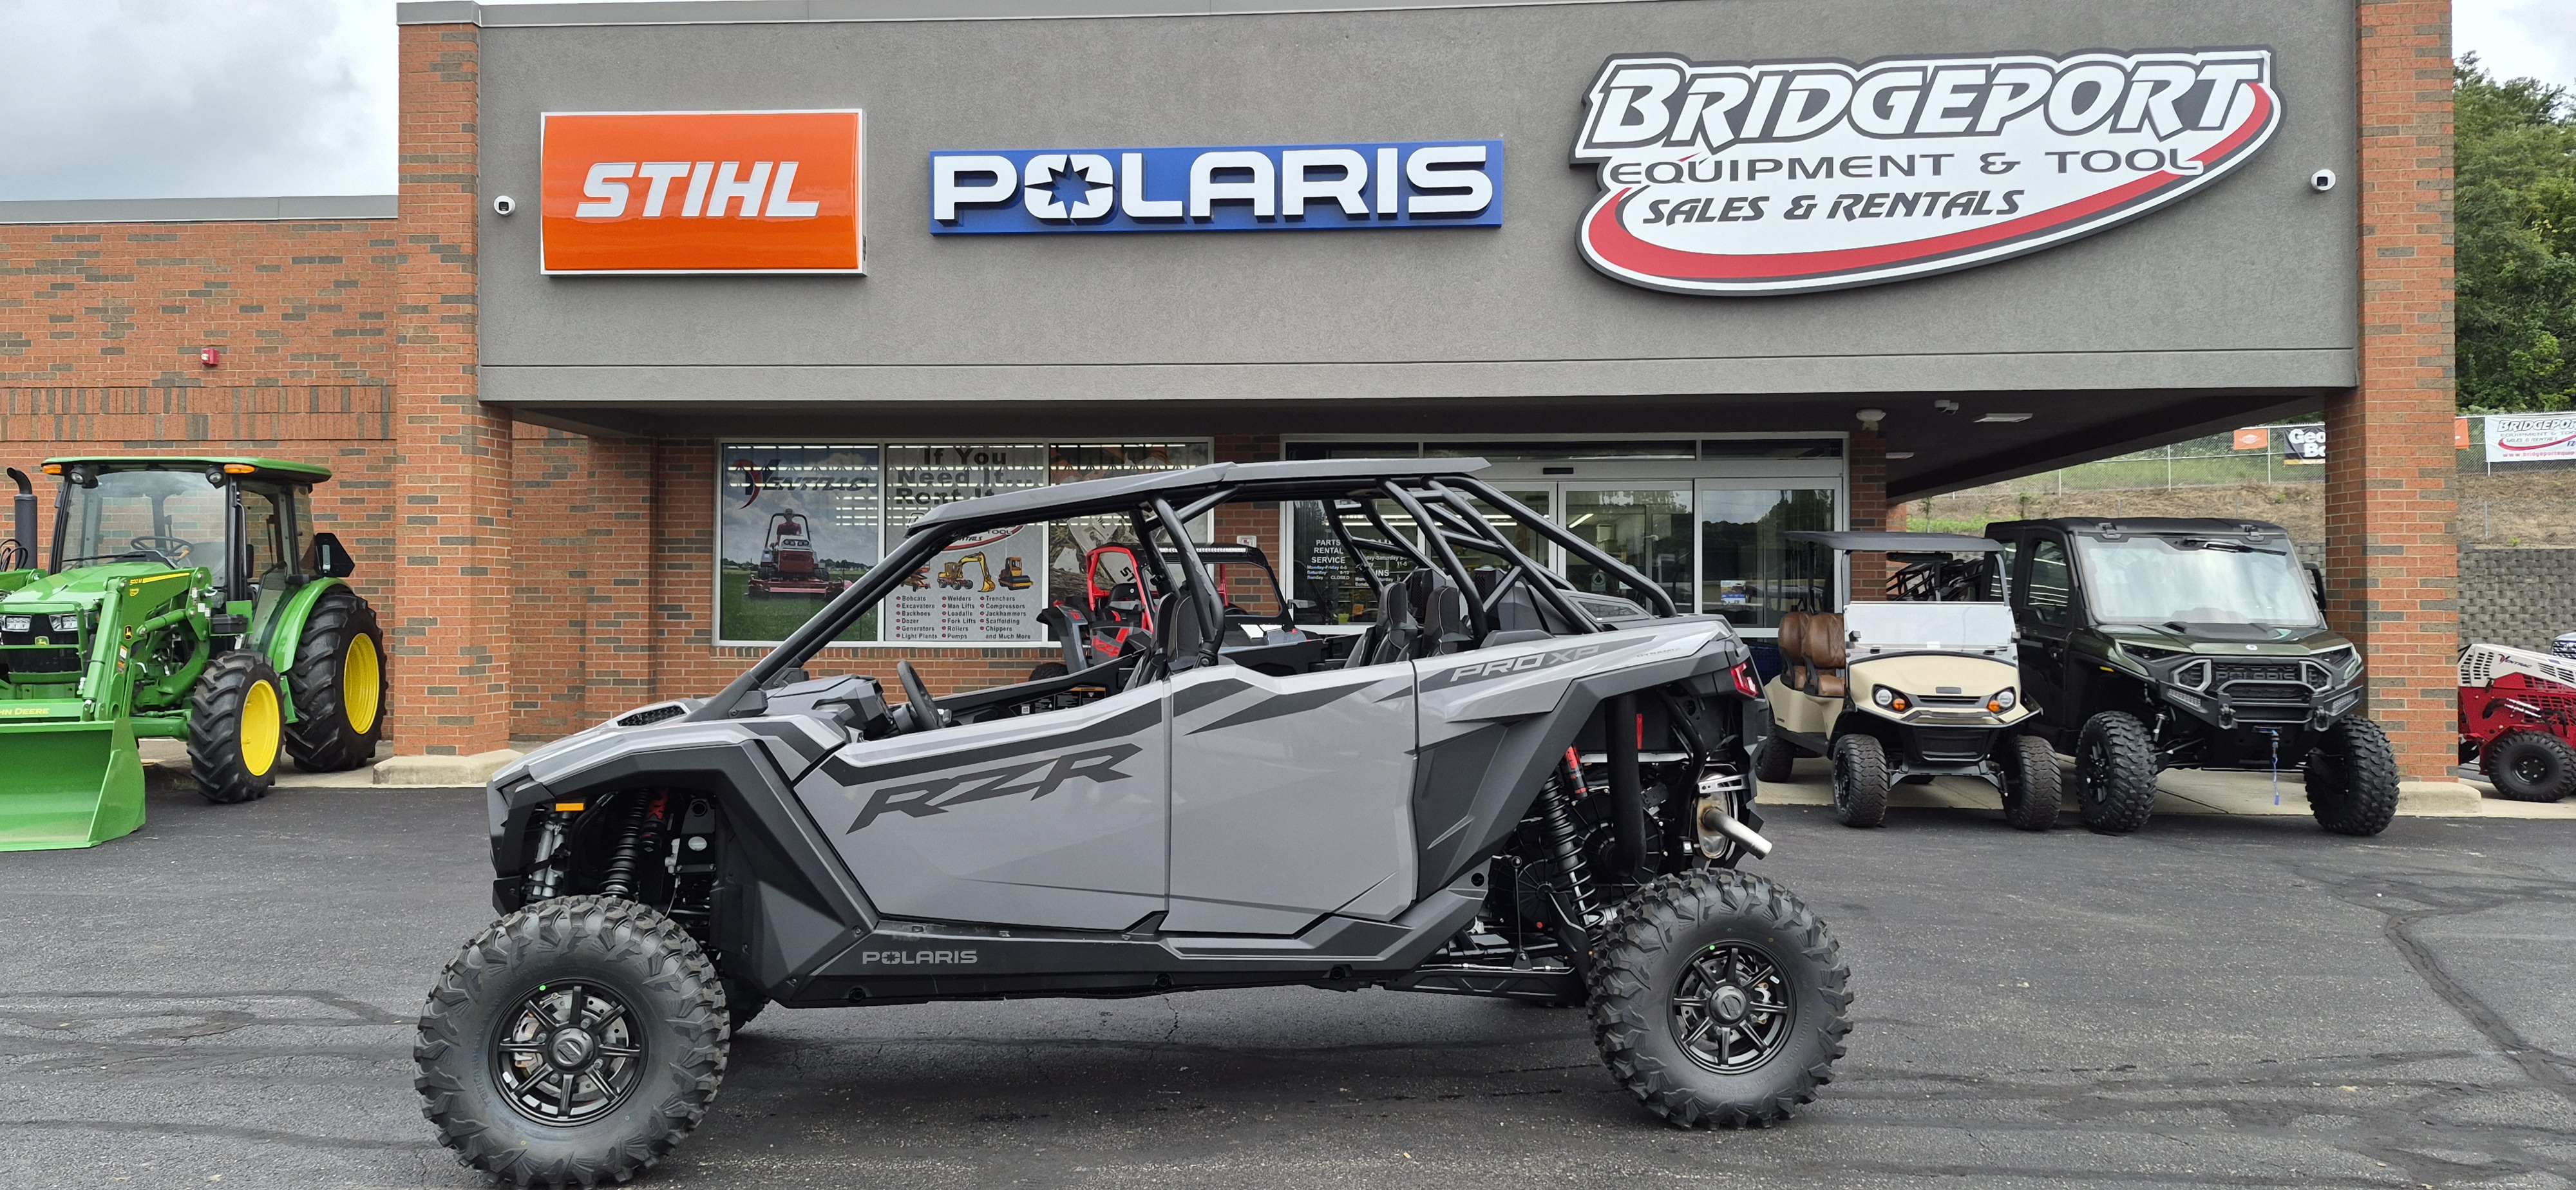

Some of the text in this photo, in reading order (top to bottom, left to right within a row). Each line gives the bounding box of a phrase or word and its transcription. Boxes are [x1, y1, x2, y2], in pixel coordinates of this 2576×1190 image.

[1587, 61, 2262, 149] BRIDGEPORT
[934, 146, 1493, 222] POLARIS
[1609, 149, 2199, 185] EQUIPMENT & TOOL
[575, 162, 820, 217] STIHL
[1642, 189, 2025, 227] SALES & RENTALS
[923, 448, 1007, 465] If You
[898, 468, 970, 484] Need
[896, 487, 962, 504] Rent
[1450, 645, 1600, 683] PRO XP
[2215, 671, 2297, 681] POLARIS
[2498, 654, 2532, 668] VENTRAC
[846, 743, 1143, 835] RZR
[862, 950, 978, 965] POLARIS
